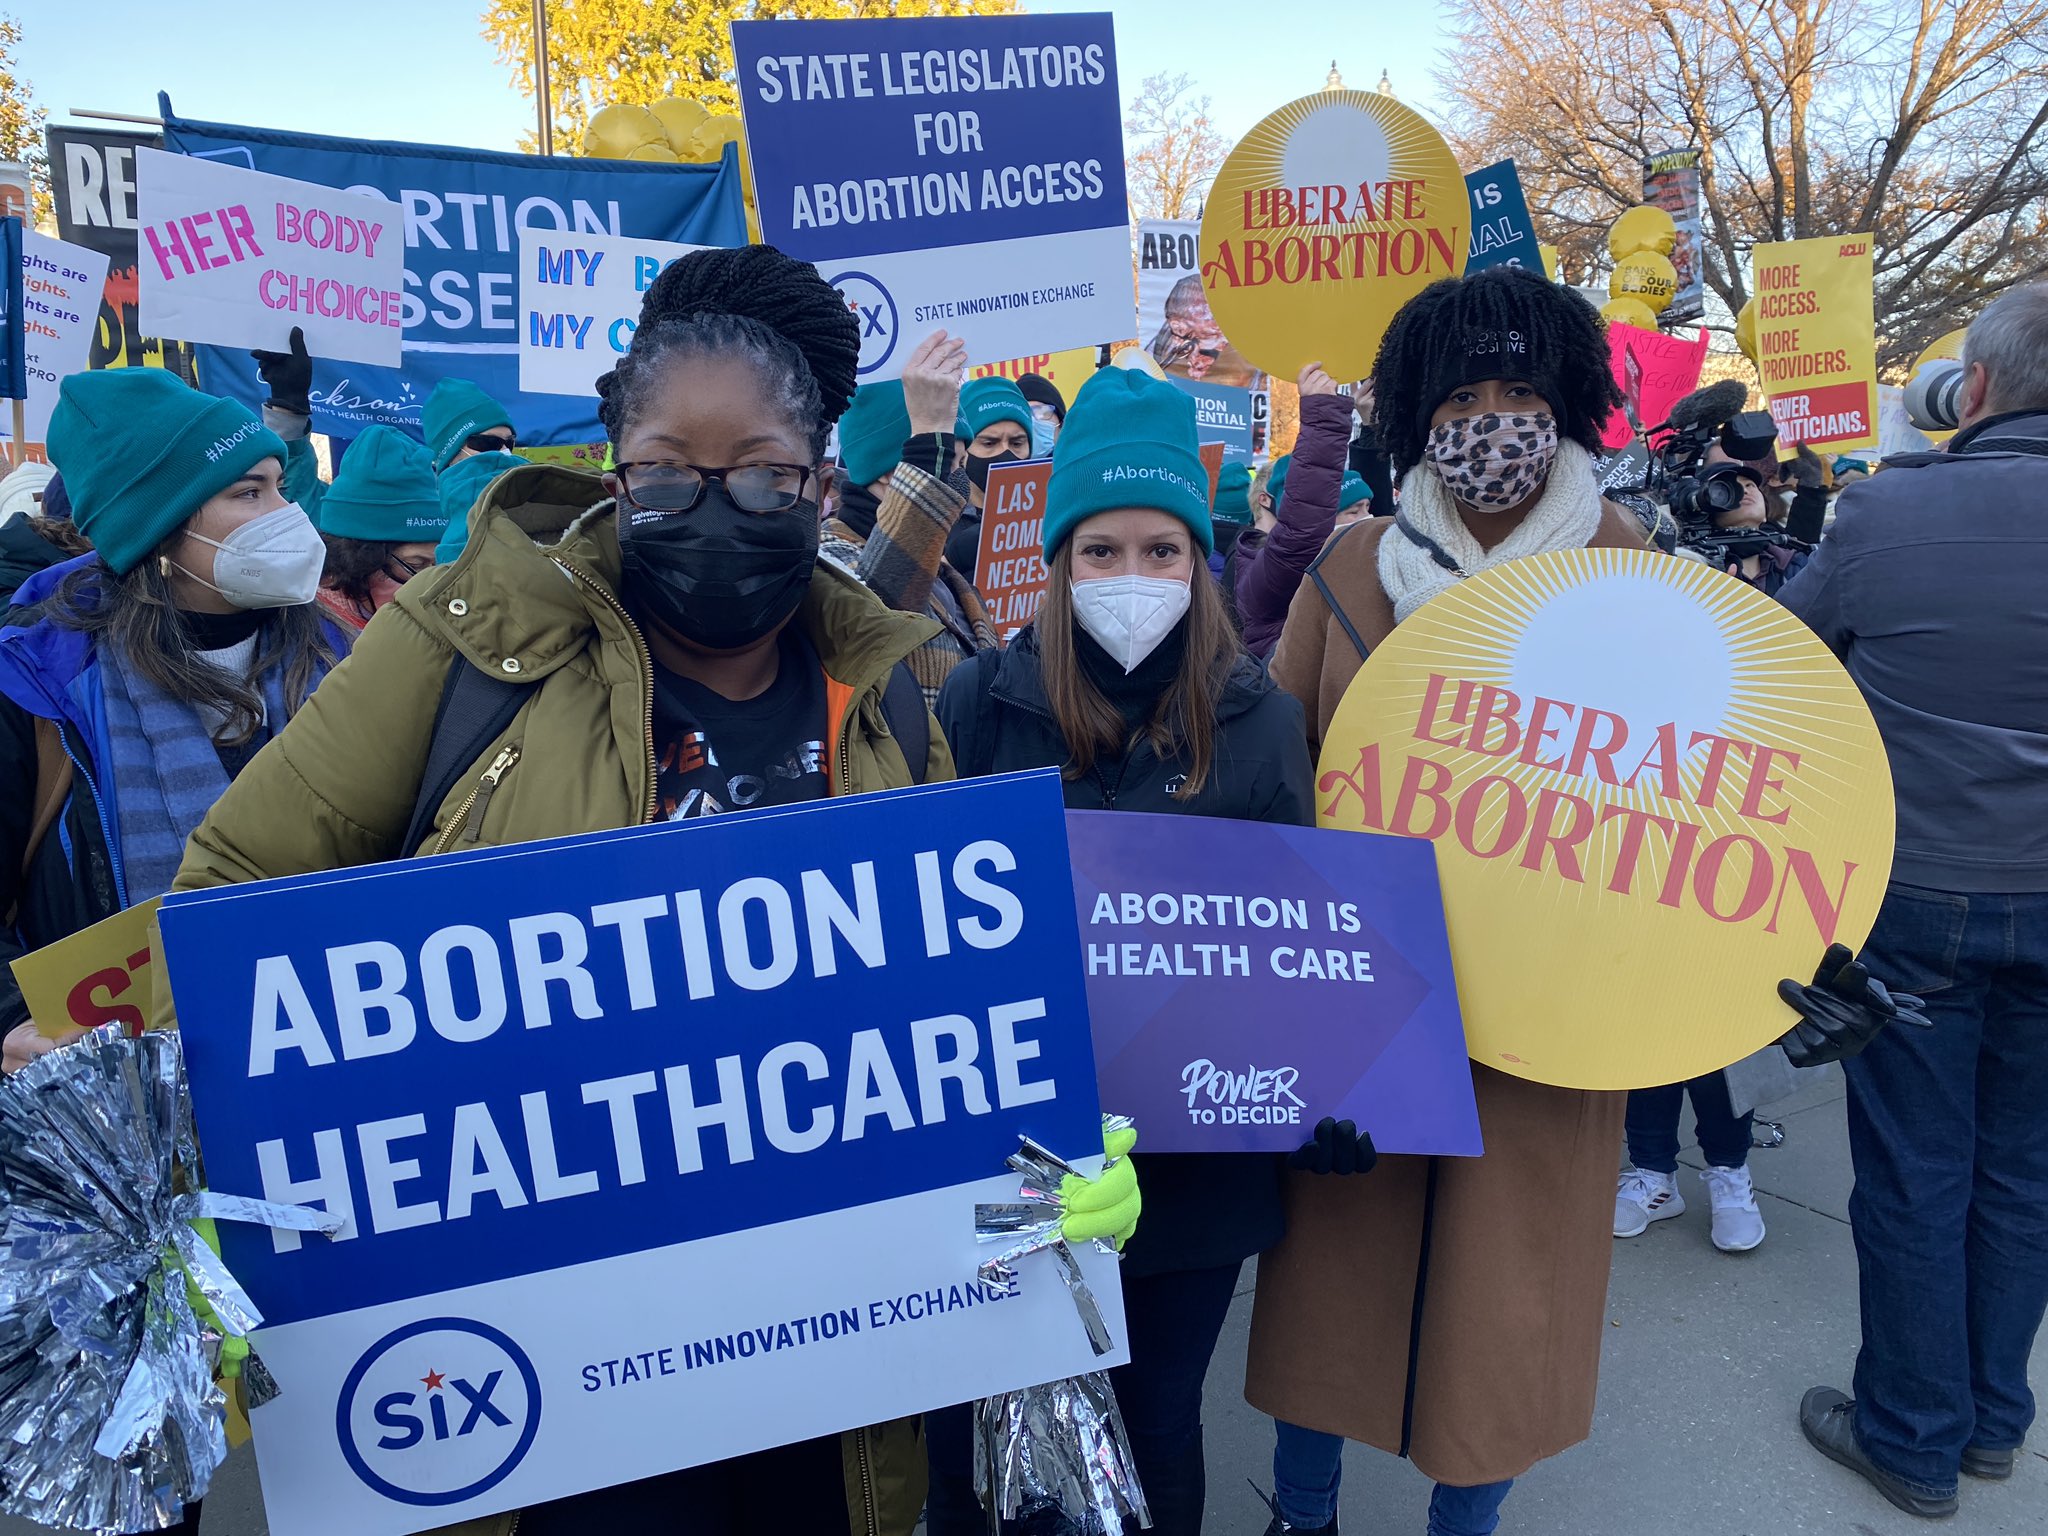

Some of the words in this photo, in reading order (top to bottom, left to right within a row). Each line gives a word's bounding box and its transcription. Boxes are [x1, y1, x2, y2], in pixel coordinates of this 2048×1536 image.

[756, 53, 874, 103] STATE
[880, 43, 1106, 97] LEGISLATORS
[914, 110, 983, 156] FOR
[64, 142, 138, 230] RE
[792, 170, 972, 230] ABORTION
[980, 158, 1104, 210] ACCESS
[1243, 179, 1426, 231] LIBERATE
[1473, 182, 1503, 210] IS
[343, 184, 622, 252] RTION
[143, 204, 265, 280] HER
[275, 202, 384, 258] BODY
[1141, 232, 1200, 271] ABO
[1202, 227, 1458, 290] ABORTION
[1839, 243, 1867, 258] ACLU
[61, 267, 88, 282] are
[538, 246, 604, 287] MY
[1647, 276, 1673, 288] OUR
[1760, 264, 1800, 291] MORE
[259, 269, 401, 328] CHOICE
[915, 303, 954, 323] STATE
[956, 291, 1029, 316] INNOVATION
[1032, 282, 1095, 305] EXCHANGE
[1621, 284, 1667, 297] BODIES
[1760, 290, 1821, 320] ACCESS.
[53, 308, 80, 323] are
[530, 311, 594, 350] MY
[1761, 329, 1800, 356] MORE
[25, 364, 57, 383] PRO
[1764, 349, 1852, 383] PROVIDERS.
[309, 403, 337, 417] MEN'S
[337, 410, 375, 422] HEALTH
[376, 413, 425, 428] ORGANIZ
[1195, 410, 1247, 426] ENTIAL
[1770, 394, 1810, 421] FEWER
[996, 480, 1037, 515] LAS
[991, 518, 1045, 553] COMU
[986, 554, 1050, 591] NECES
[1412, 673, 1801, 827] LIBERATE
[1317, 742, 1860, 948] ABORTION
[1090, 892, 1309, 930] ABORTION
[1327, 901, 1362, 934] IS
[247, 860, 887, 1078] ABORTION
[914, 839, 1025, 958] IS
[1087, 942, 1251, 978] HEALTH
[1269, 947, 1375, 983] CARE
[1179, 1057, 1308, 1108] POWER
[256, 997, 1057, 1254] HEALTHCARE
[1188, 1108, 1216, 1125] TO
[1220, 1105, 1301, 1125] DECIDE
[581, 1347, 676, 1395] STATE
[682, 1307, 861, 1371] INNOVATION
